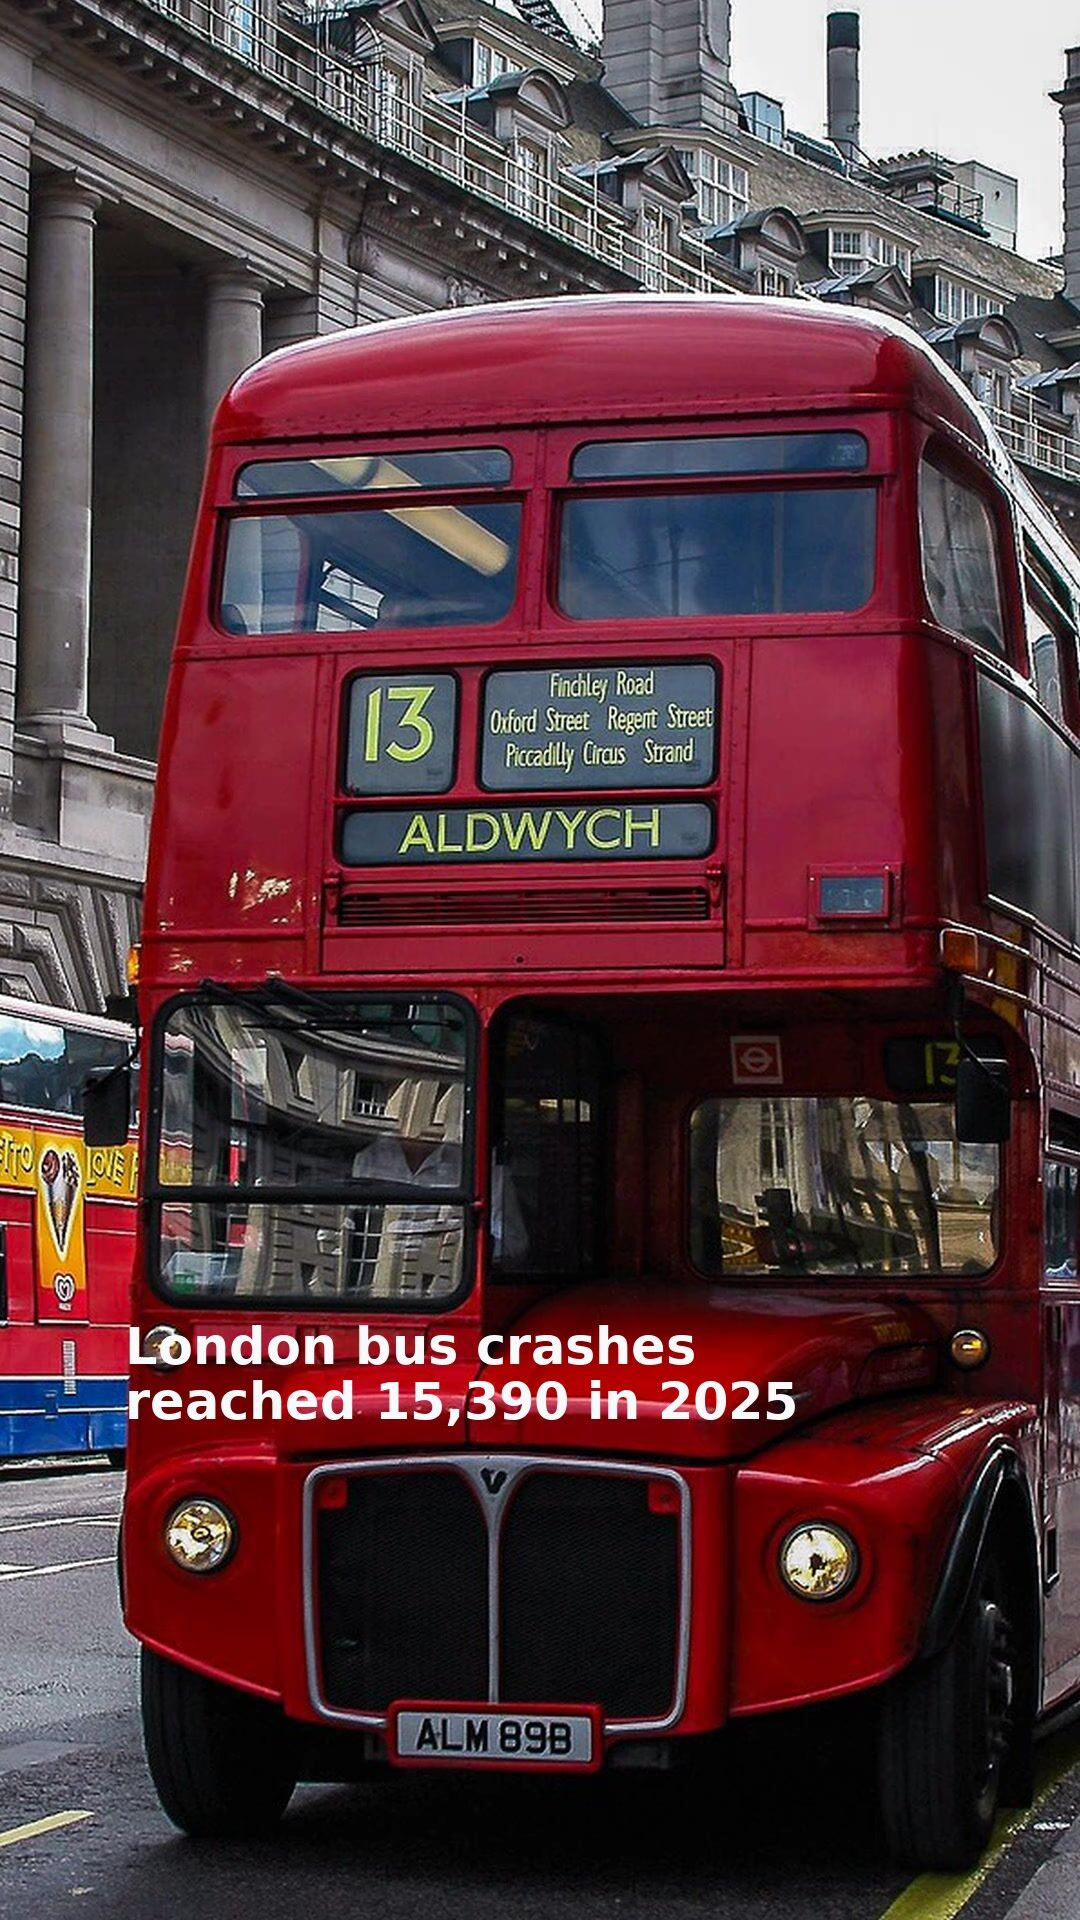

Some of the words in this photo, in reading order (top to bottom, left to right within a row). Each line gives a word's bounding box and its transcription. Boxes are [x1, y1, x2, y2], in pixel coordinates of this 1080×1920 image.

[550, 671, 609, 703] Finchley
[616, 670, 654, 696] Road
[364, 686, 435, 763] 13
[490, 709, 538, 736] Oxford
[545, 707, 590, 733] Street
[607, 706, 658, 737] Regent
[667, 703, 714, 729] Street
[505, 741, 575, 774] Piccadilly
[582, 740, 626, 767] Circus
[643, 738, 694, 764] Strand
[398, 808, 660, 854] ALDWYCH
[924, 1041, 961, 1086] 13
[86, 1147, 126, 1187] LOVE
[416, 1718, 488, 1752] ALM
[499, 1720, 572, 1755] 89B
